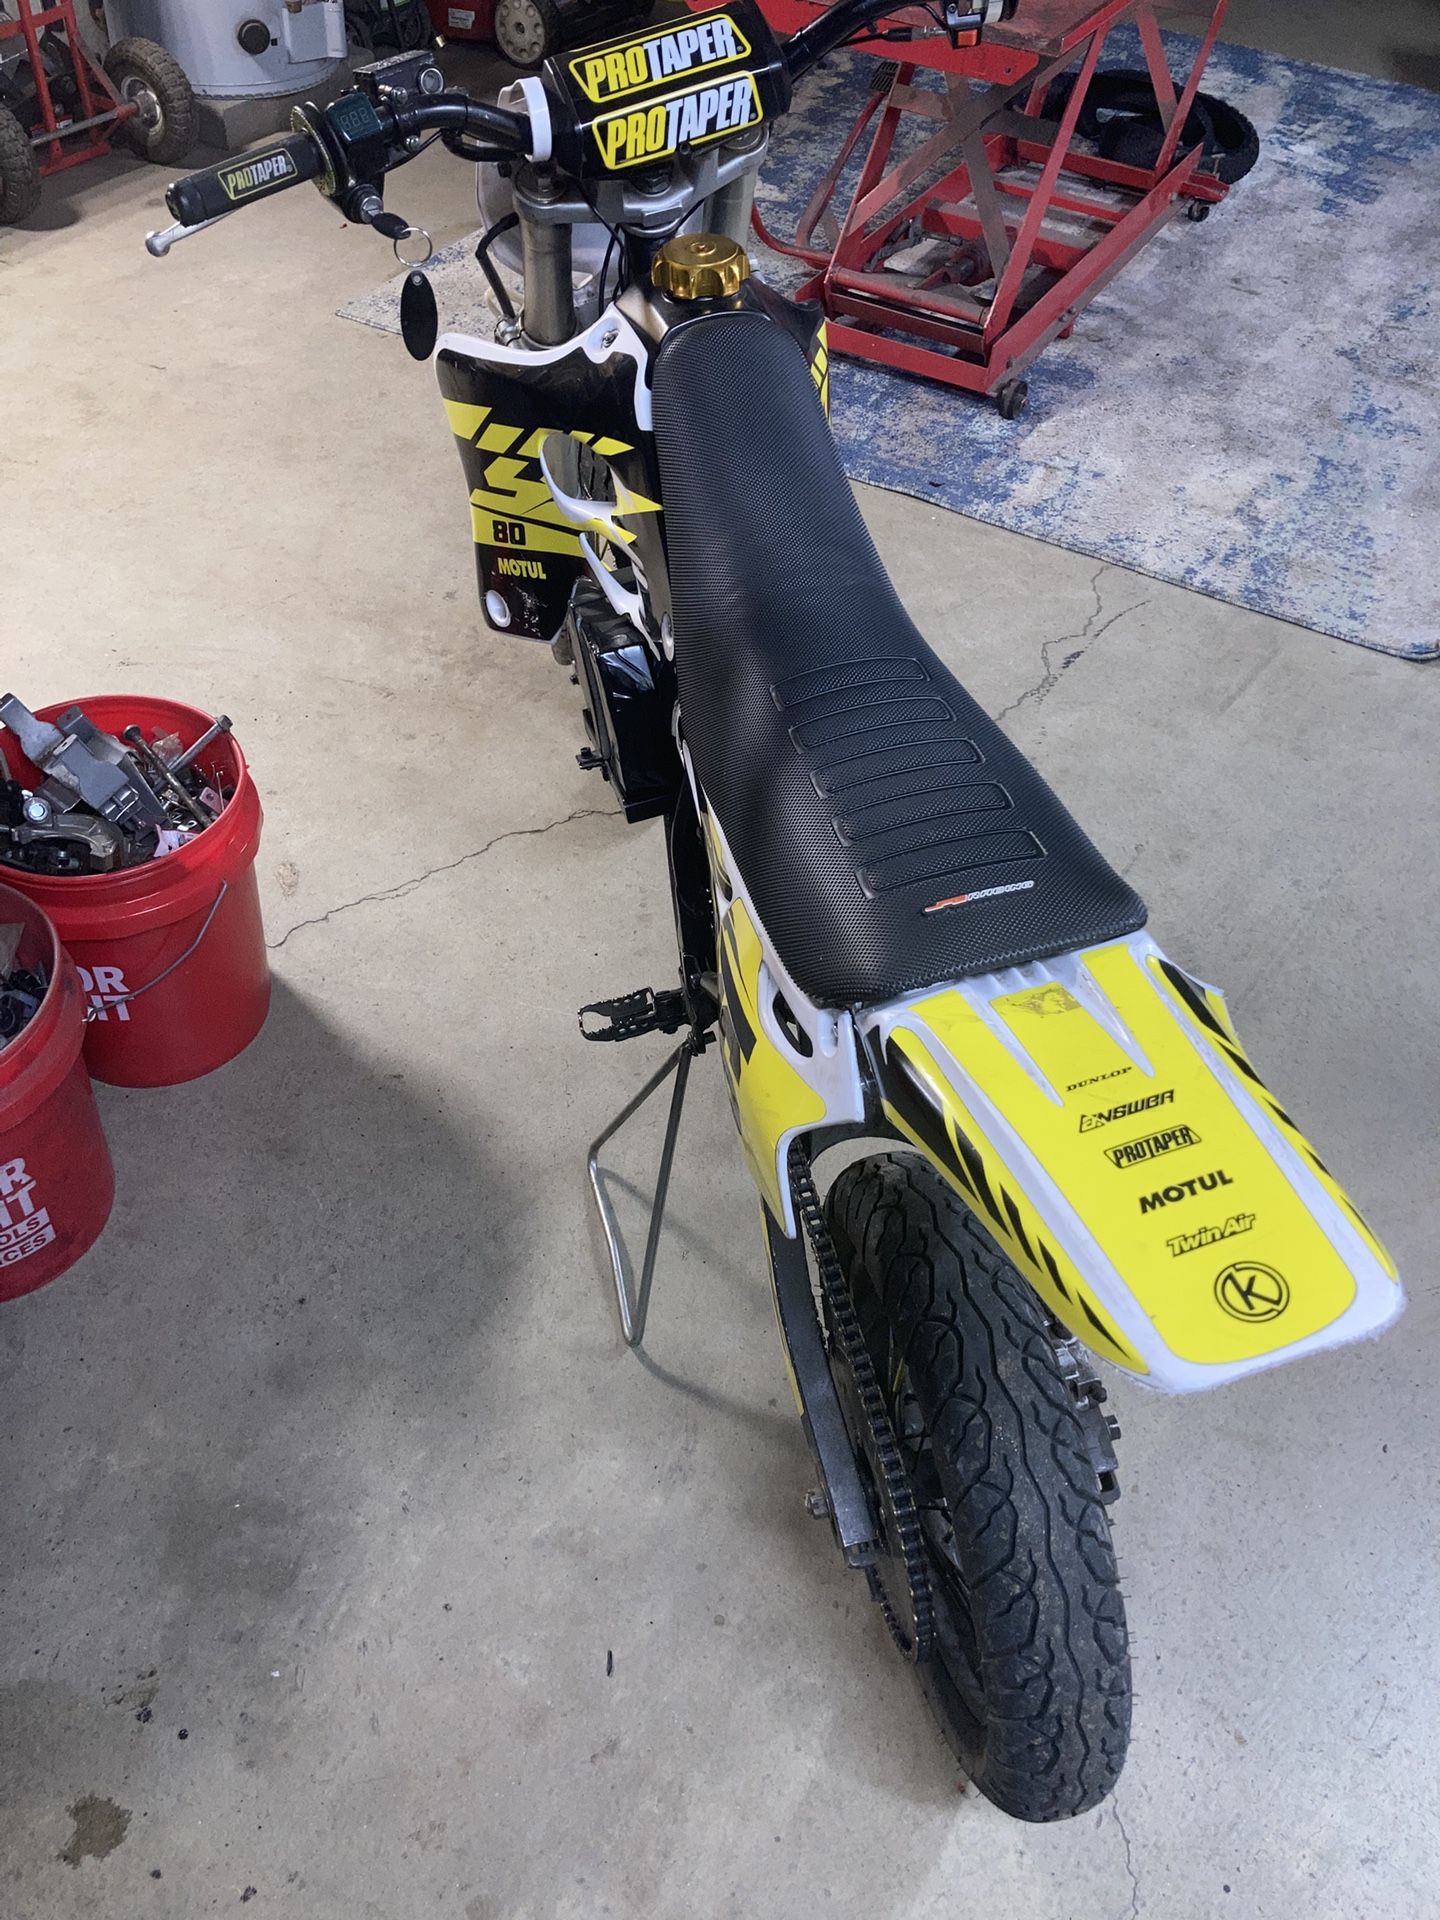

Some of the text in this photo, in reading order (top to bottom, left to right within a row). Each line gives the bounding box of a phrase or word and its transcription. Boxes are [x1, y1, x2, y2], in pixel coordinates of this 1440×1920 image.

[585, 19, 737, 98] PROTAPER
[607, 78, 752, 167] PROTAPER
[227, 154, 288, 199] PROTAPER
[492, 520, 526, 545] 80
[497, 557, 547, 580] MOTUL
[1066, 1066, 1133, 1092] DUNLOP
[1079, 1089, 1175, 1133] ANSWER
[1112, 1125, 1195, 1168] PROTAPER
[1138, 1169, 1234, 1215] MOTUL
